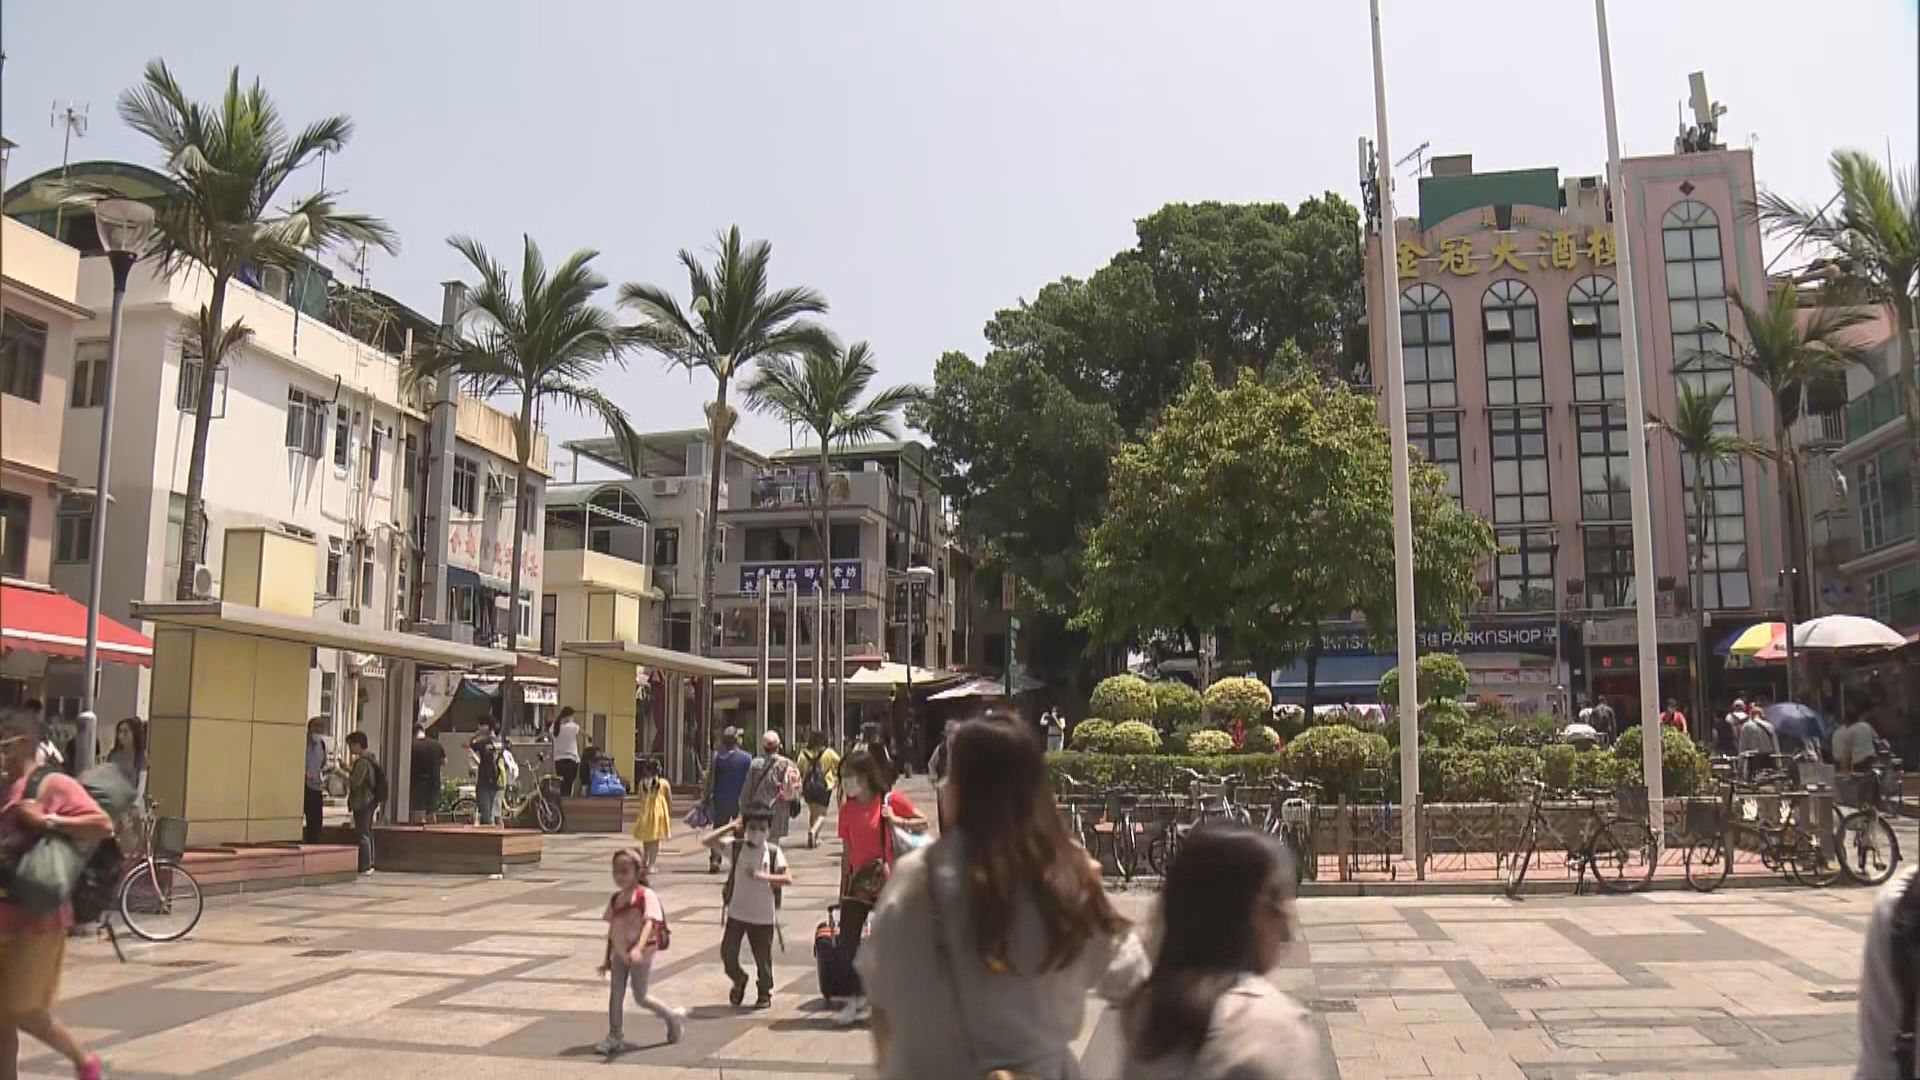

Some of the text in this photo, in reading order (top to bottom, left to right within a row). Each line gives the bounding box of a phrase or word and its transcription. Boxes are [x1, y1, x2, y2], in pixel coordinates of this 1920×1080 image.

[1397, 229, 1616, 278] 金冠大酒樓
